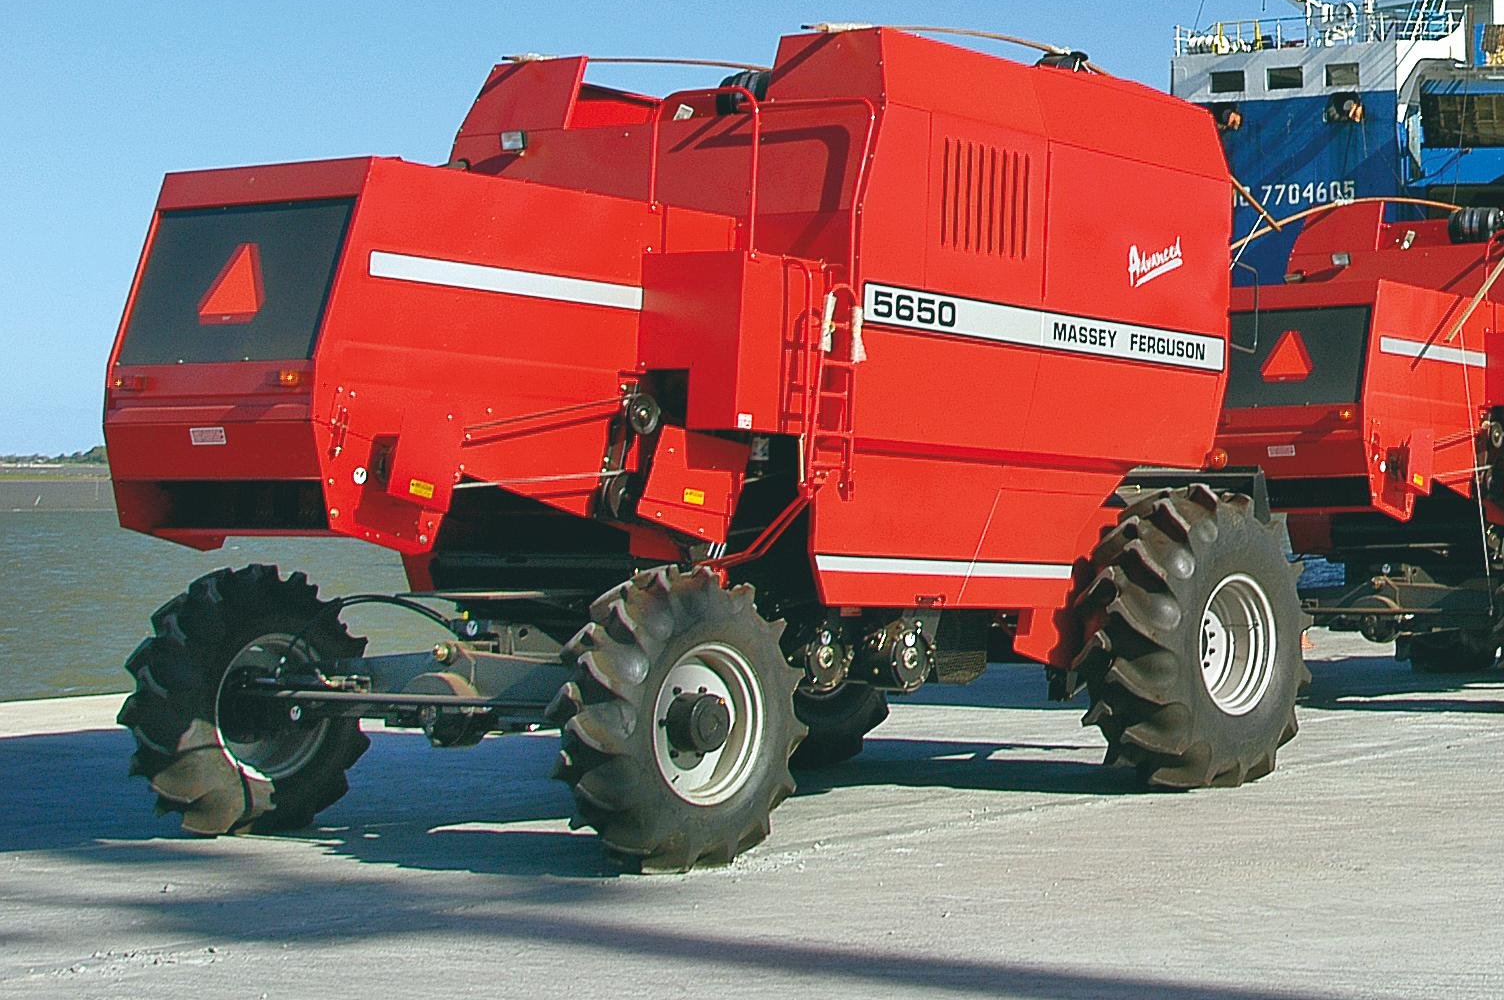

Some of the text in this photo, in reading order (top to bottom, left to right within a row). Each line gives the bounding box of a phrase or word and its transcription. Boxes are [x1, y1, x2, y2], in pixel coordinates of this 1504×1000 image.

[1261, 180, 1355, 206] 7704605
[1127, 235, 1183, 288] Advanced
[873, 290, 1206, 361] 5650 MASSEY FERGUSON
